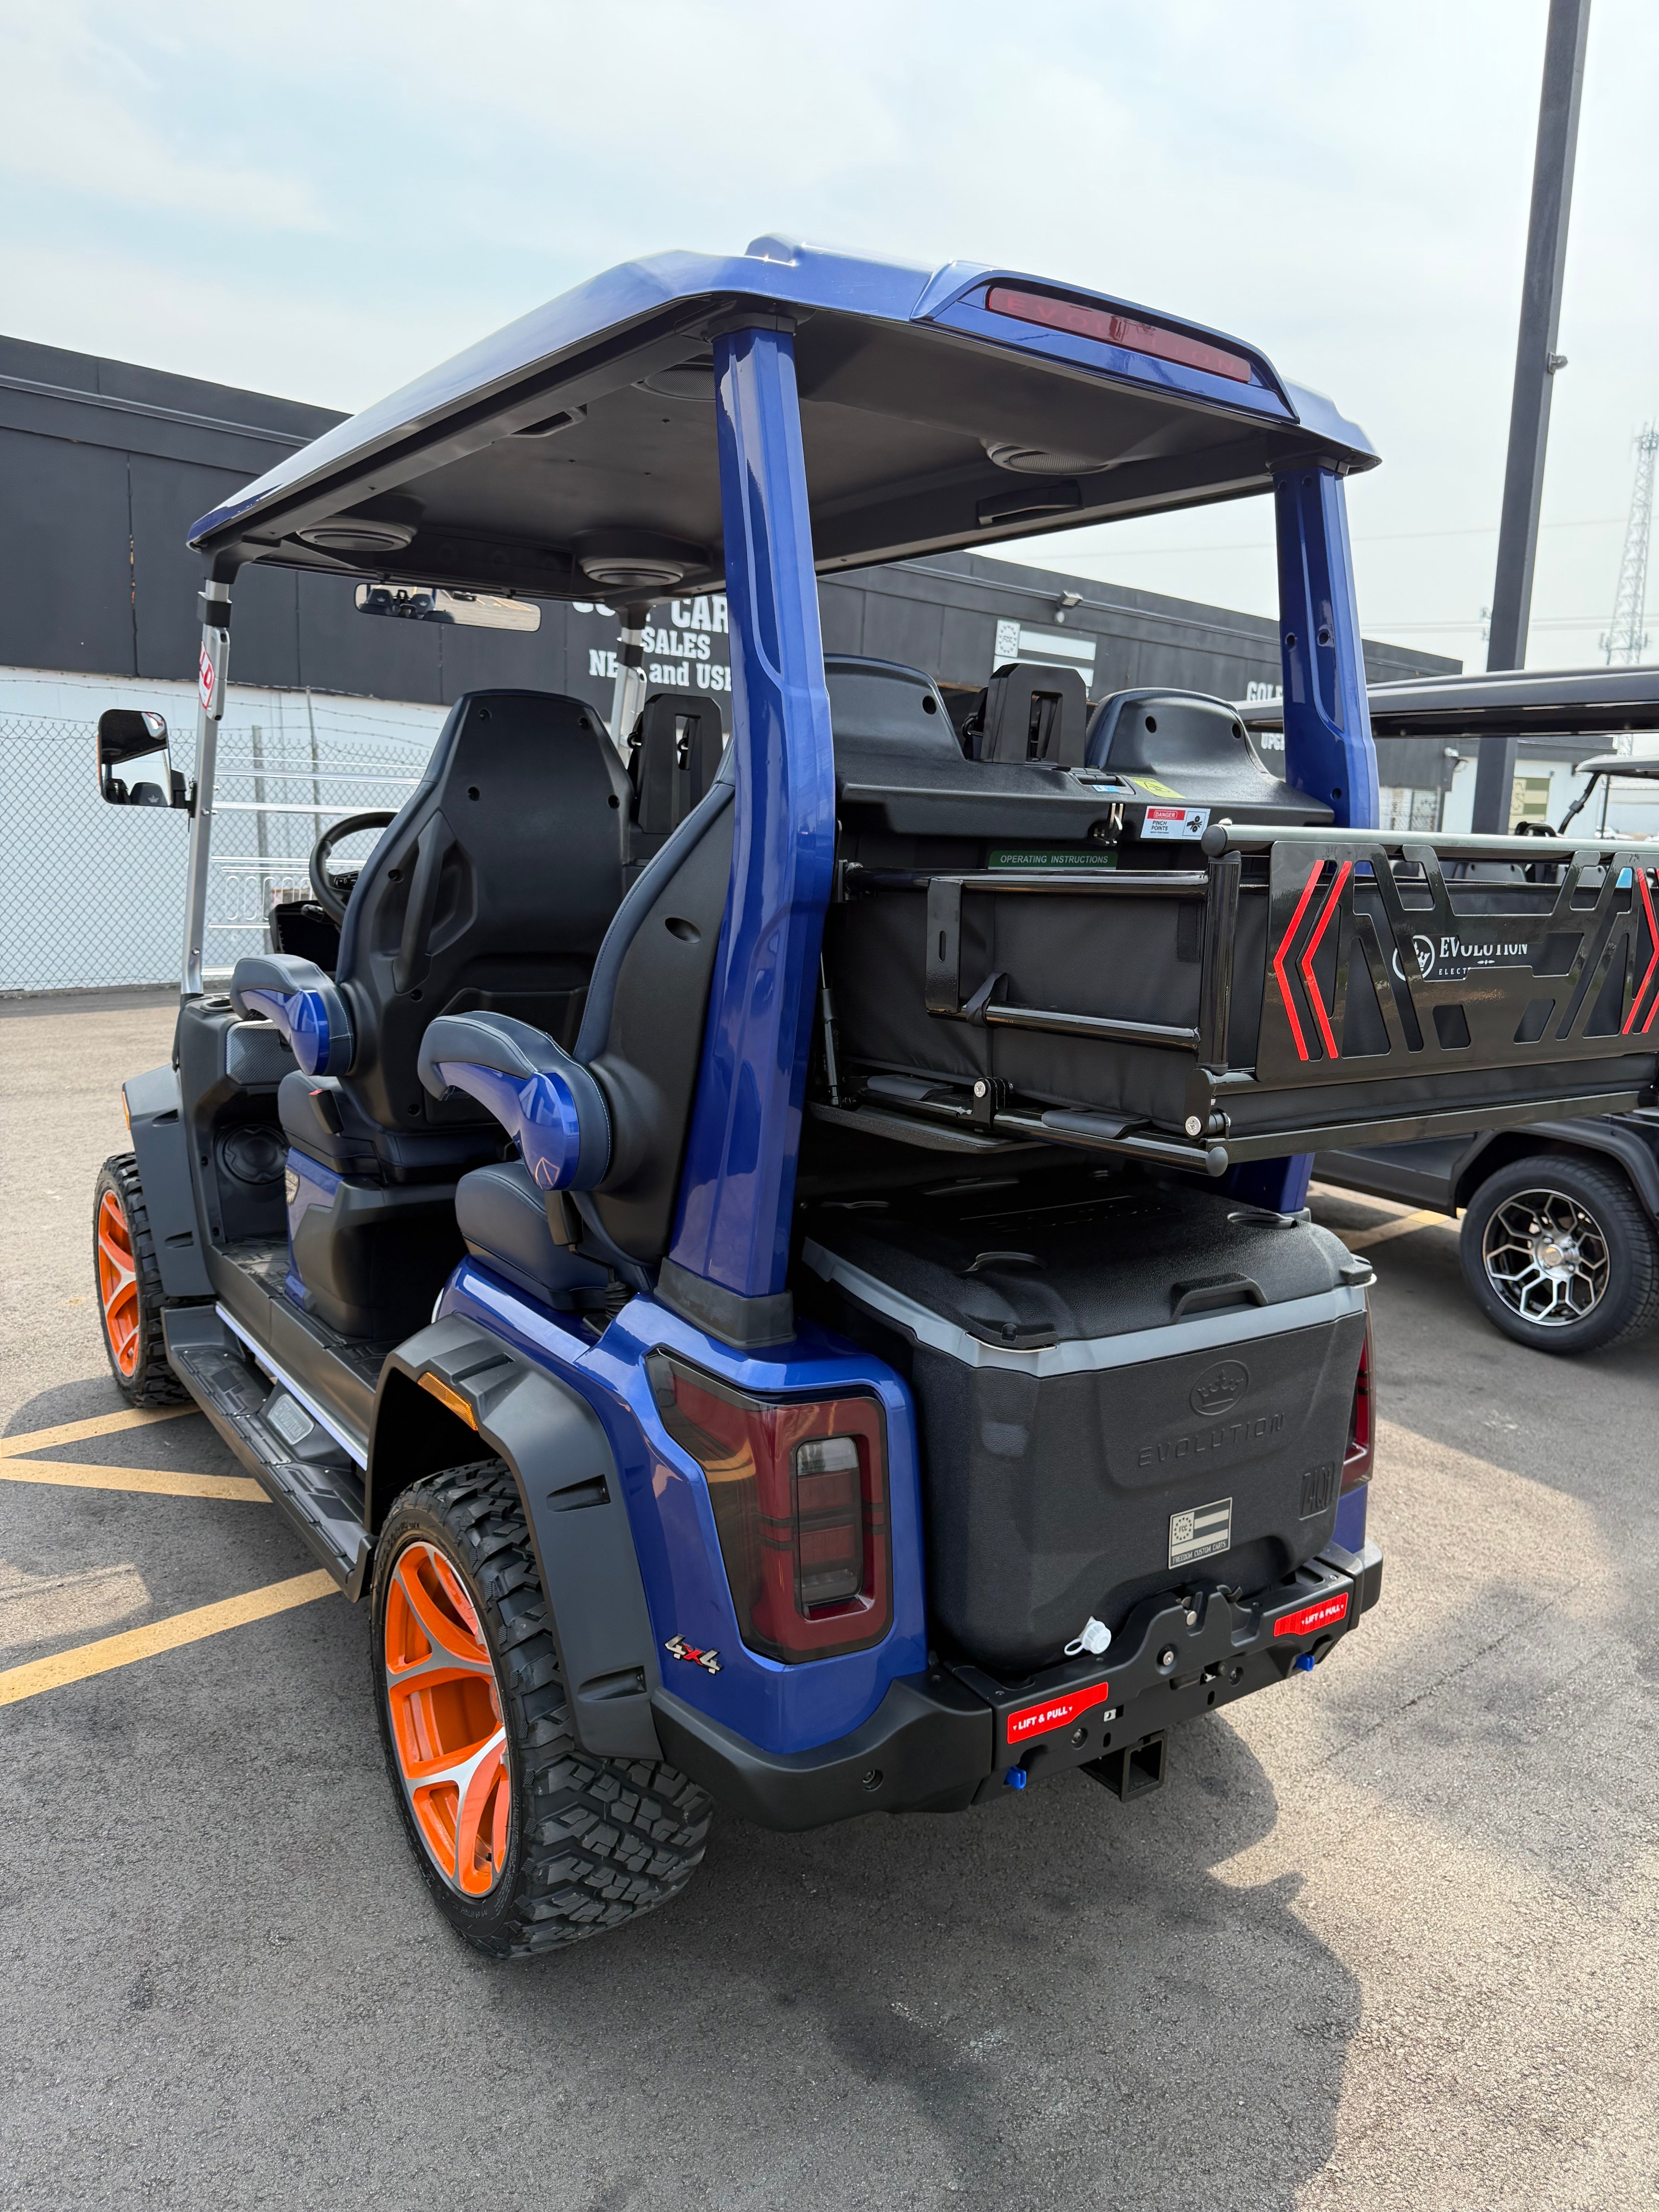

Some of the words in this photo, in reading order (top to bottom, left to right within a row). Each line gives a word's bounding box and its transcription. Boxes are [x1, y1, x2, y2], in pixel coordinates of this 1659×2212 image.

[641, 626, 711, 660] SALES
[589, 649, 619, 678] NE
[649, 661, 689, 686] and
[1138, 1413, 1285, 1468] EVOLUTION
[1173, 1551, 1193, 1564] FREEDOM
[1194, 1546, 1211, 1557] CUSTOM
[1213, 1541, 1226, 1551] CARTS
[1305, 1613, 1319, 1625] LIFT
[1319, 1611, 1324, 1619] &
[1325, 1604, 1340, 1616] PULL
[1018, 1716, 1037, 1730] LIFT
[1038, 1714, 1045, 1723] &
[1047, 1706, 1068, 1721] PULL
